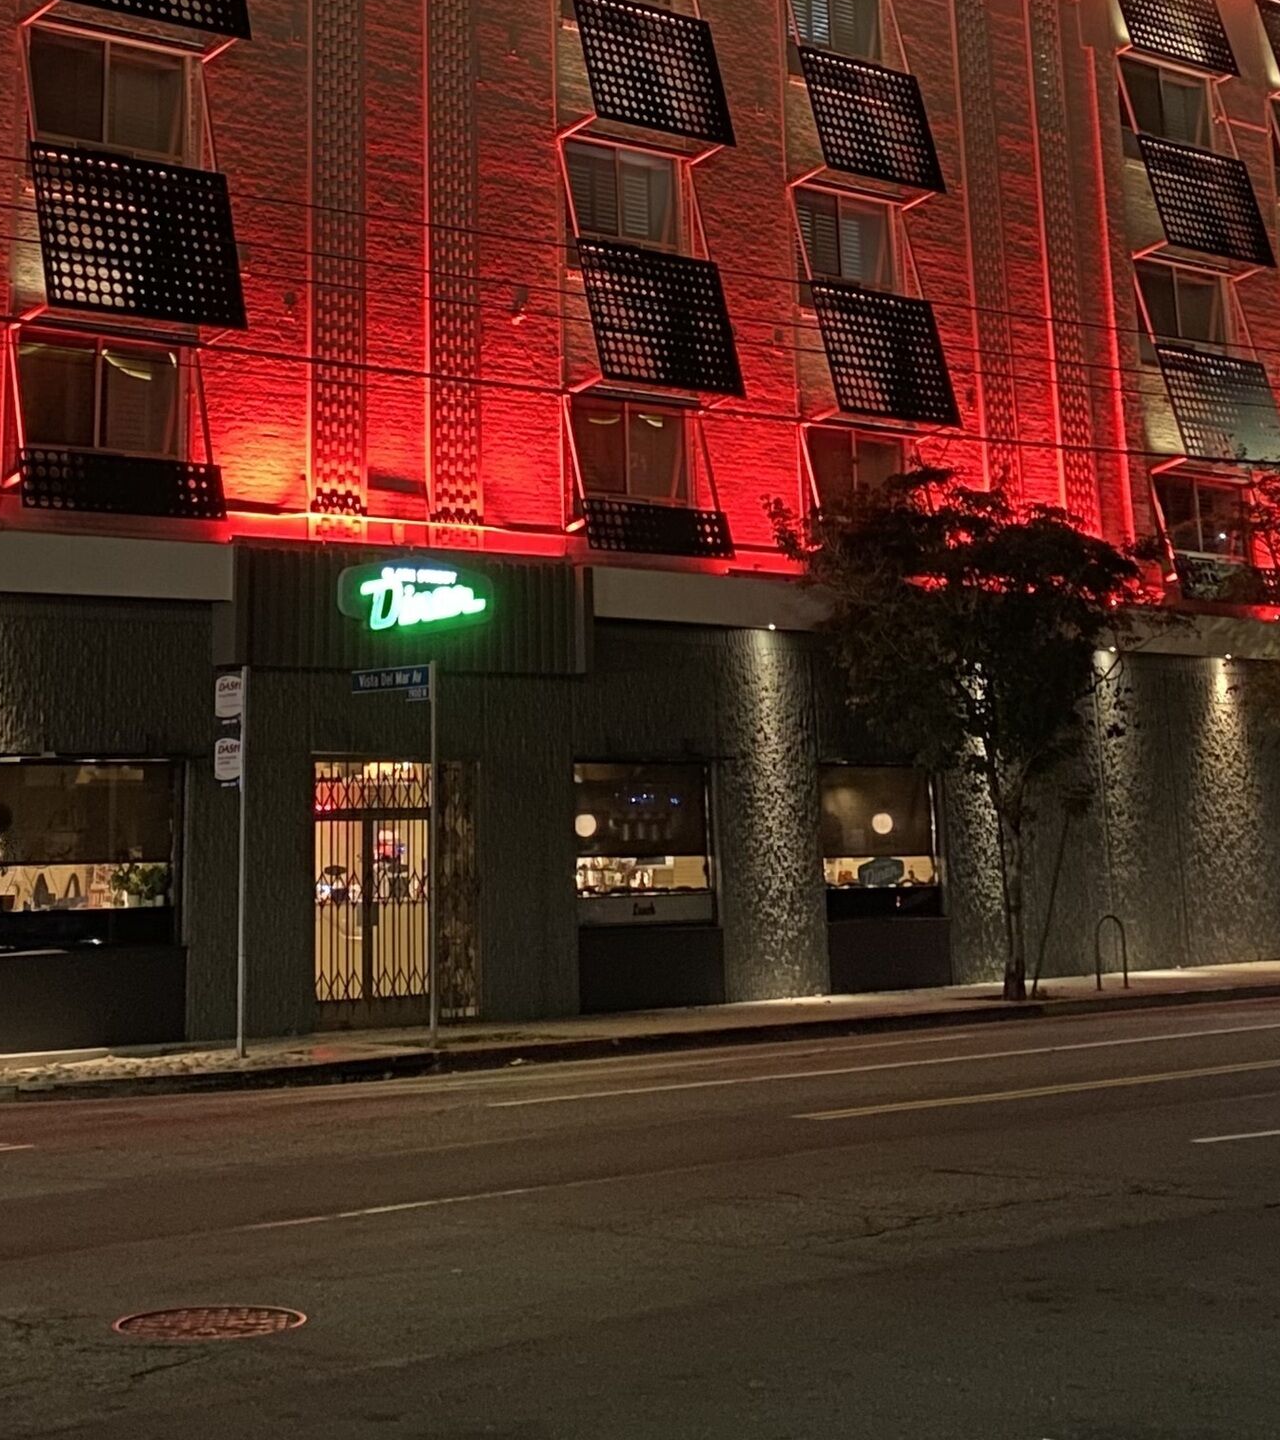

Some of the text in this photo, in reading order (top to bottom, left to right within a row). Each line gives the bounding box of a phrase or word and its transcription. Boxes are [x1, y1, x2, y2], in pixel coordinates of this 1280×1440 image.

[360, 579, 486, 630] Diner
[359, 669, 422, 689] Vista Del Mar Av
